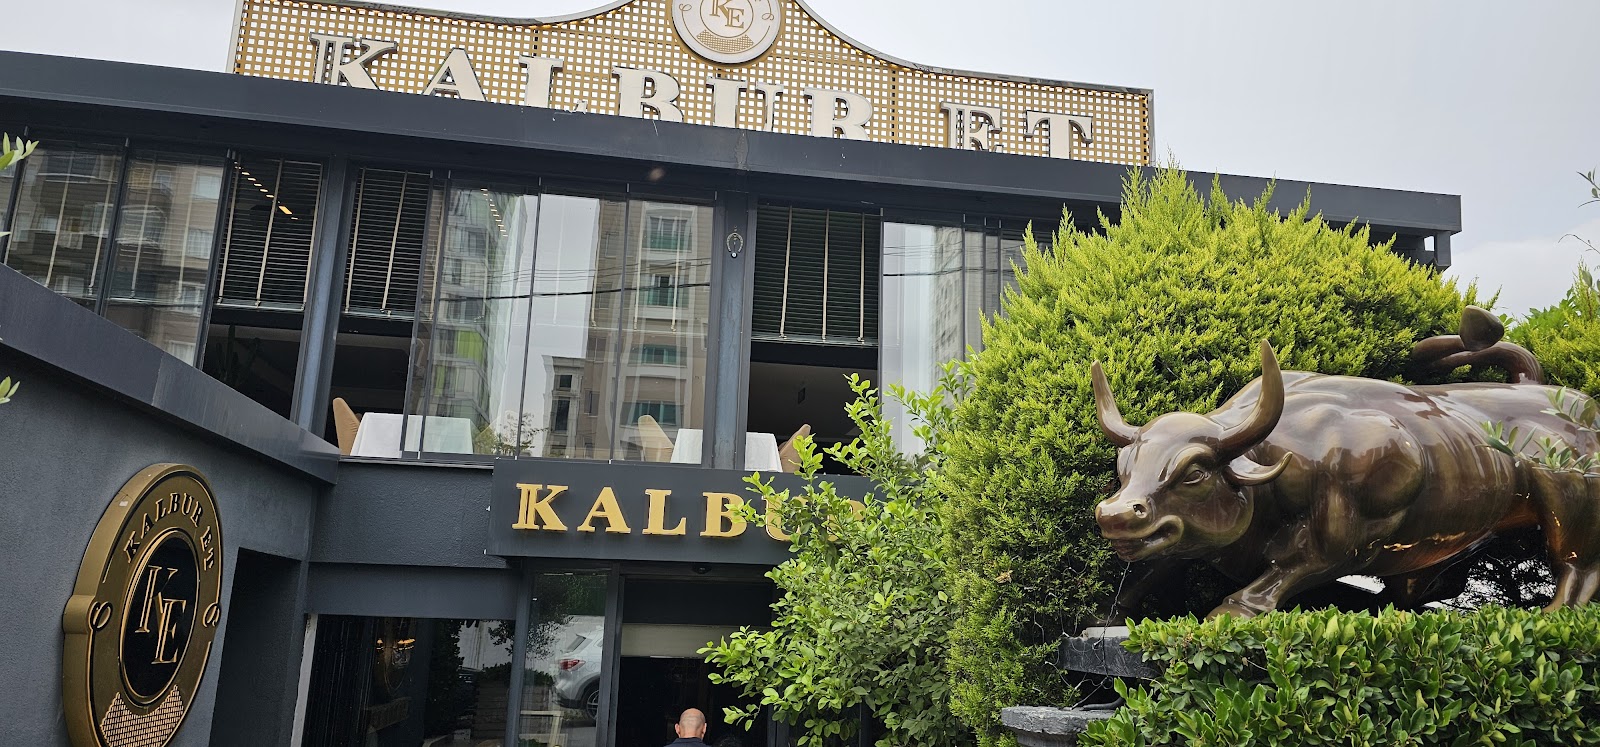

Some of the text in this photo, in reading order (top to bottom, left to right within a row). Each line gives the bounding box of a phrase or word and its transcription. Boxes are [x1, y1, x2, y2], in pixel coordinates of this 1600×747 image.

[309, 32, 1094, 160] KALBUR ET
[123, 492, 214, 572] KALBUR ET
